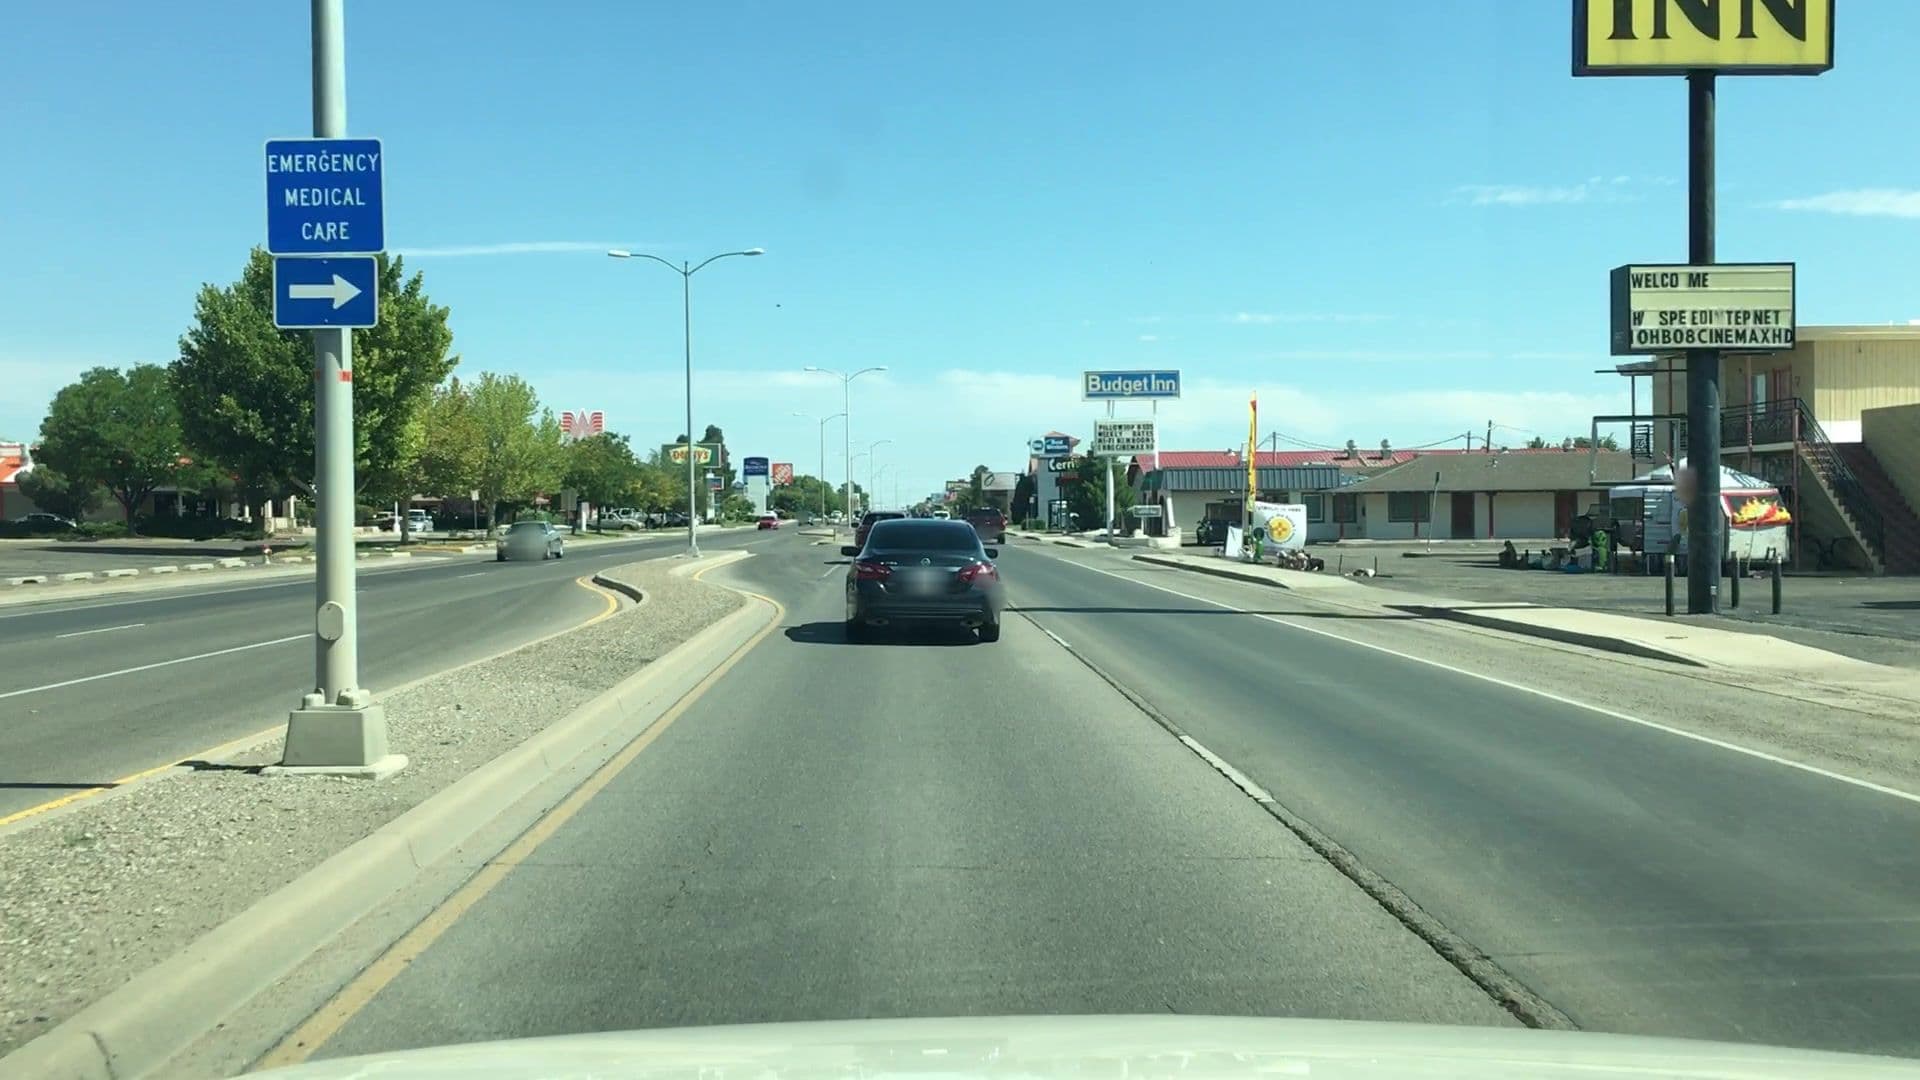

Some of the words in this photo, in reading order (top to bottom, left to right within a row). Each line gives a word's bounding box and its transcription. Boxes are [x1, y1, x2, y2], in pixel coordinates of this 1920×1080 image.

[1606, 0, 1807, 42] INN
[268, 153, 379, 173] EMERGENCY
[284, 187, 366, 207] MEDICAL
[301, 221, 350, 240] CARE
[1088, 375, 1149, 395] Budget
[1151, 373, 1176, 391] Inn
[1048, 458, 1079, 471] Cerri
